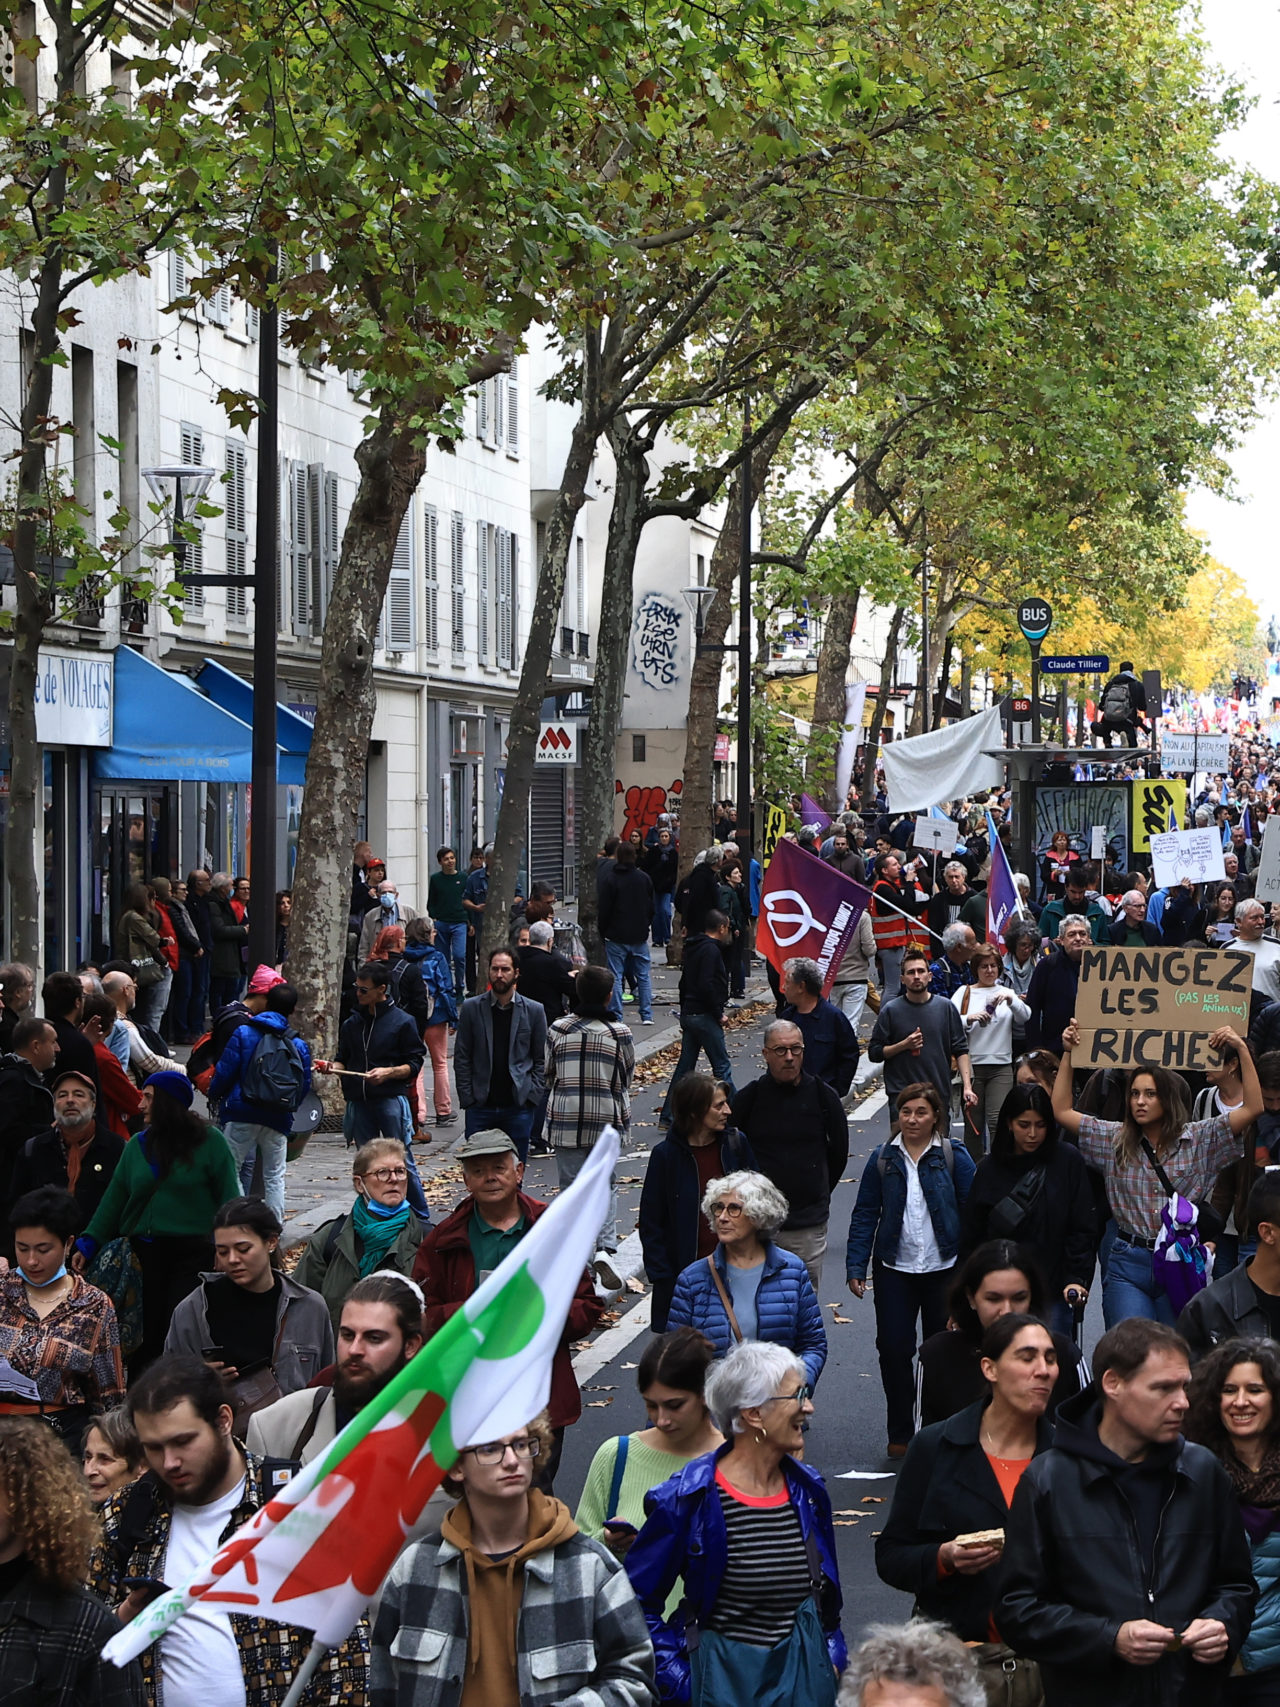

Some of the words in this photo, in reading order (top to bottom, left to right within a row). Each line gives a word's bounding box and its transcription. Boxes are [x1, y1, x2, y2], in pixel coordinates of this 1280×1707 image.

[1022, 608, 1047, 621] BUS
[44, 657, 57, 704] de
[61, 659, 110, 710] VOYAGES
[1015, 701, 1028, 710] 86
[1164, 741, 1179, 750] NON
[1180, 742, 1190, 750] AU
[1191, 742, 1227, 753] CAPITALISME
[1178, 758, 1186, 766] LA
[1201, 756, 1224, 768] CHÈRE
[1082, 950, 1251, 993] MANGEZ
[1100, 987, 1160, 1016] LES
[1202, 994, 1220, 1003] LES
